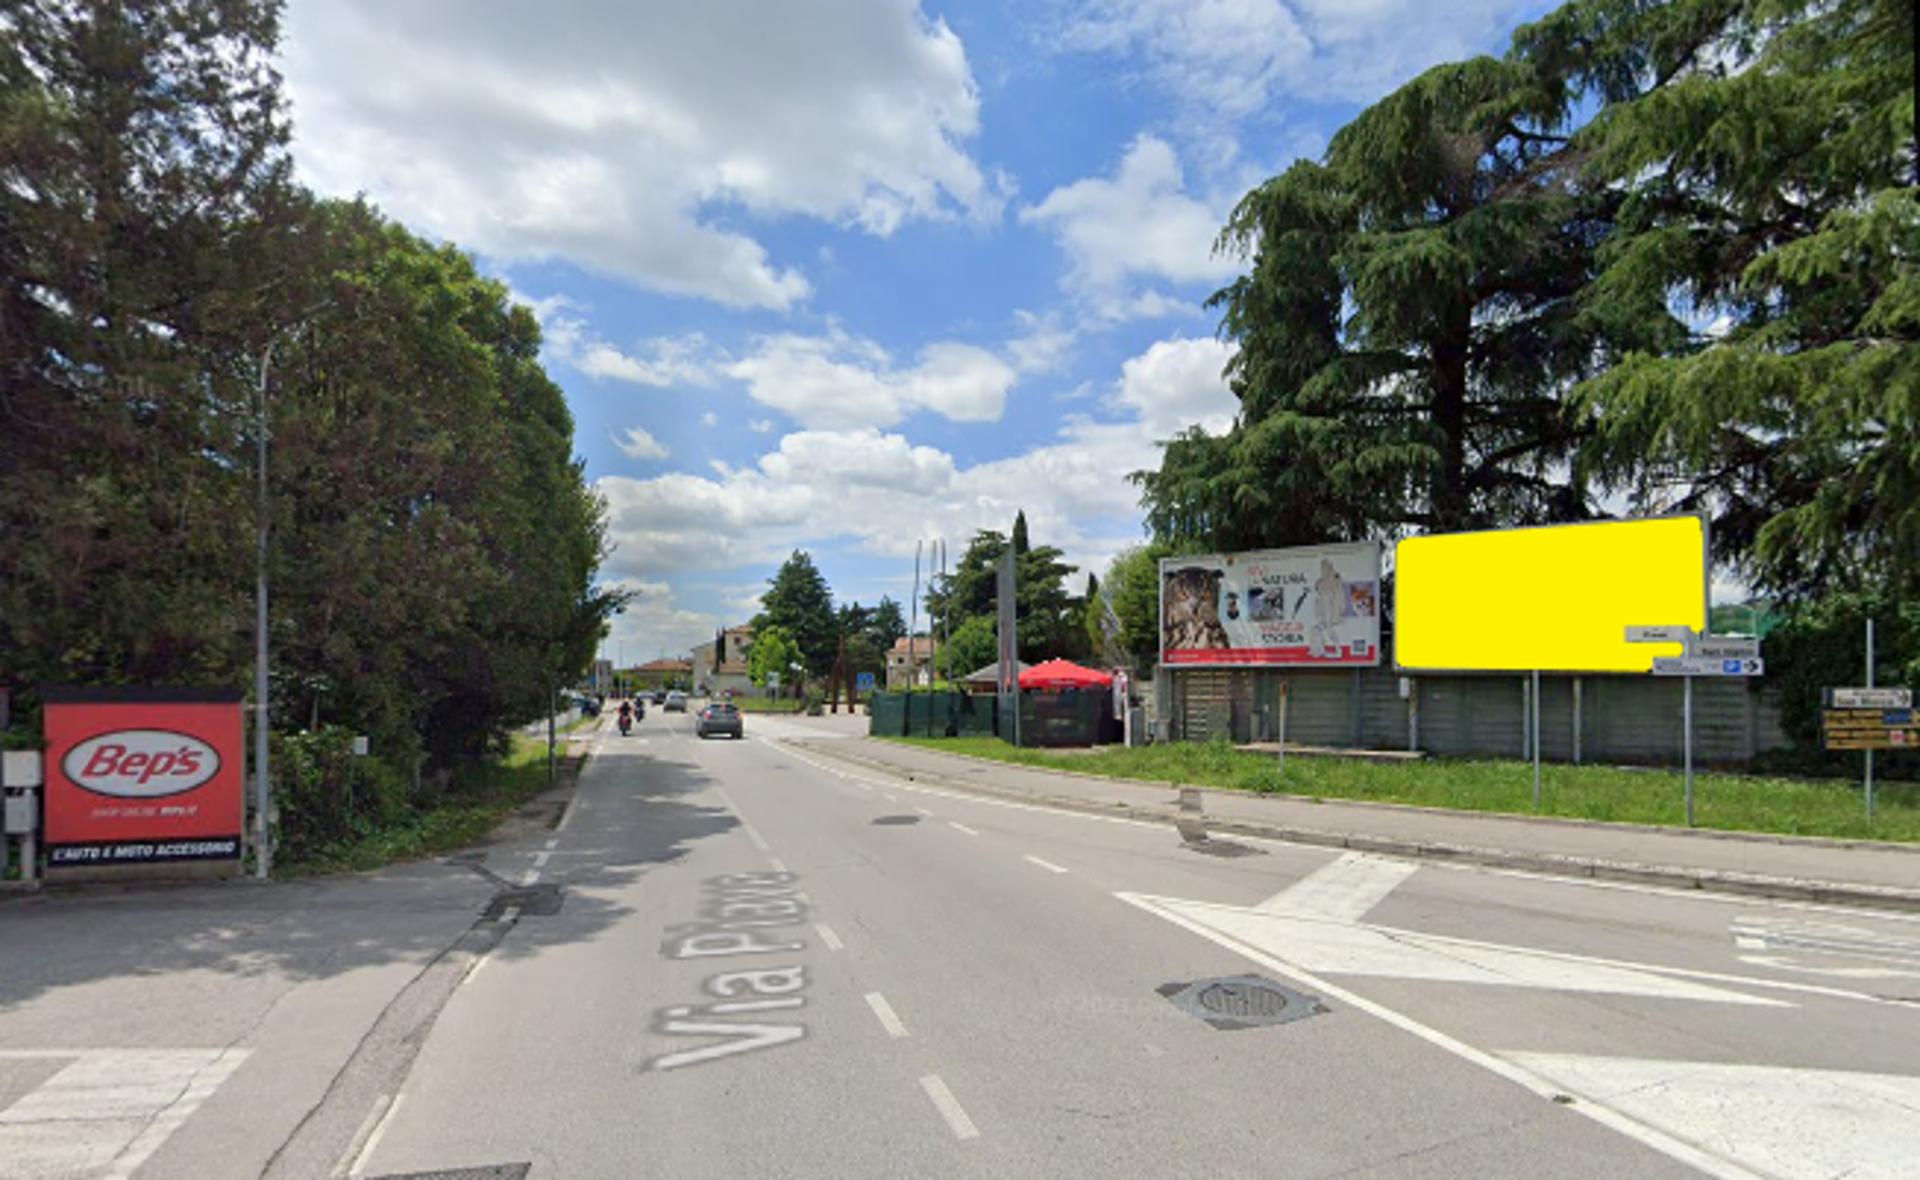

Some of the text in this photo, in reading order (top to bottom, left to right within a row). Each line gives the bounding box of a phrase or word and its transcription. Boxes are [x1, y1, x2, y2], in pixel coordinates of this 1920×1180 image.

[81, 744, 203, 784] Bep's
[113, 844, 154, 858] MOTO
[155, 841, 236, 856] ACCESSORIO
